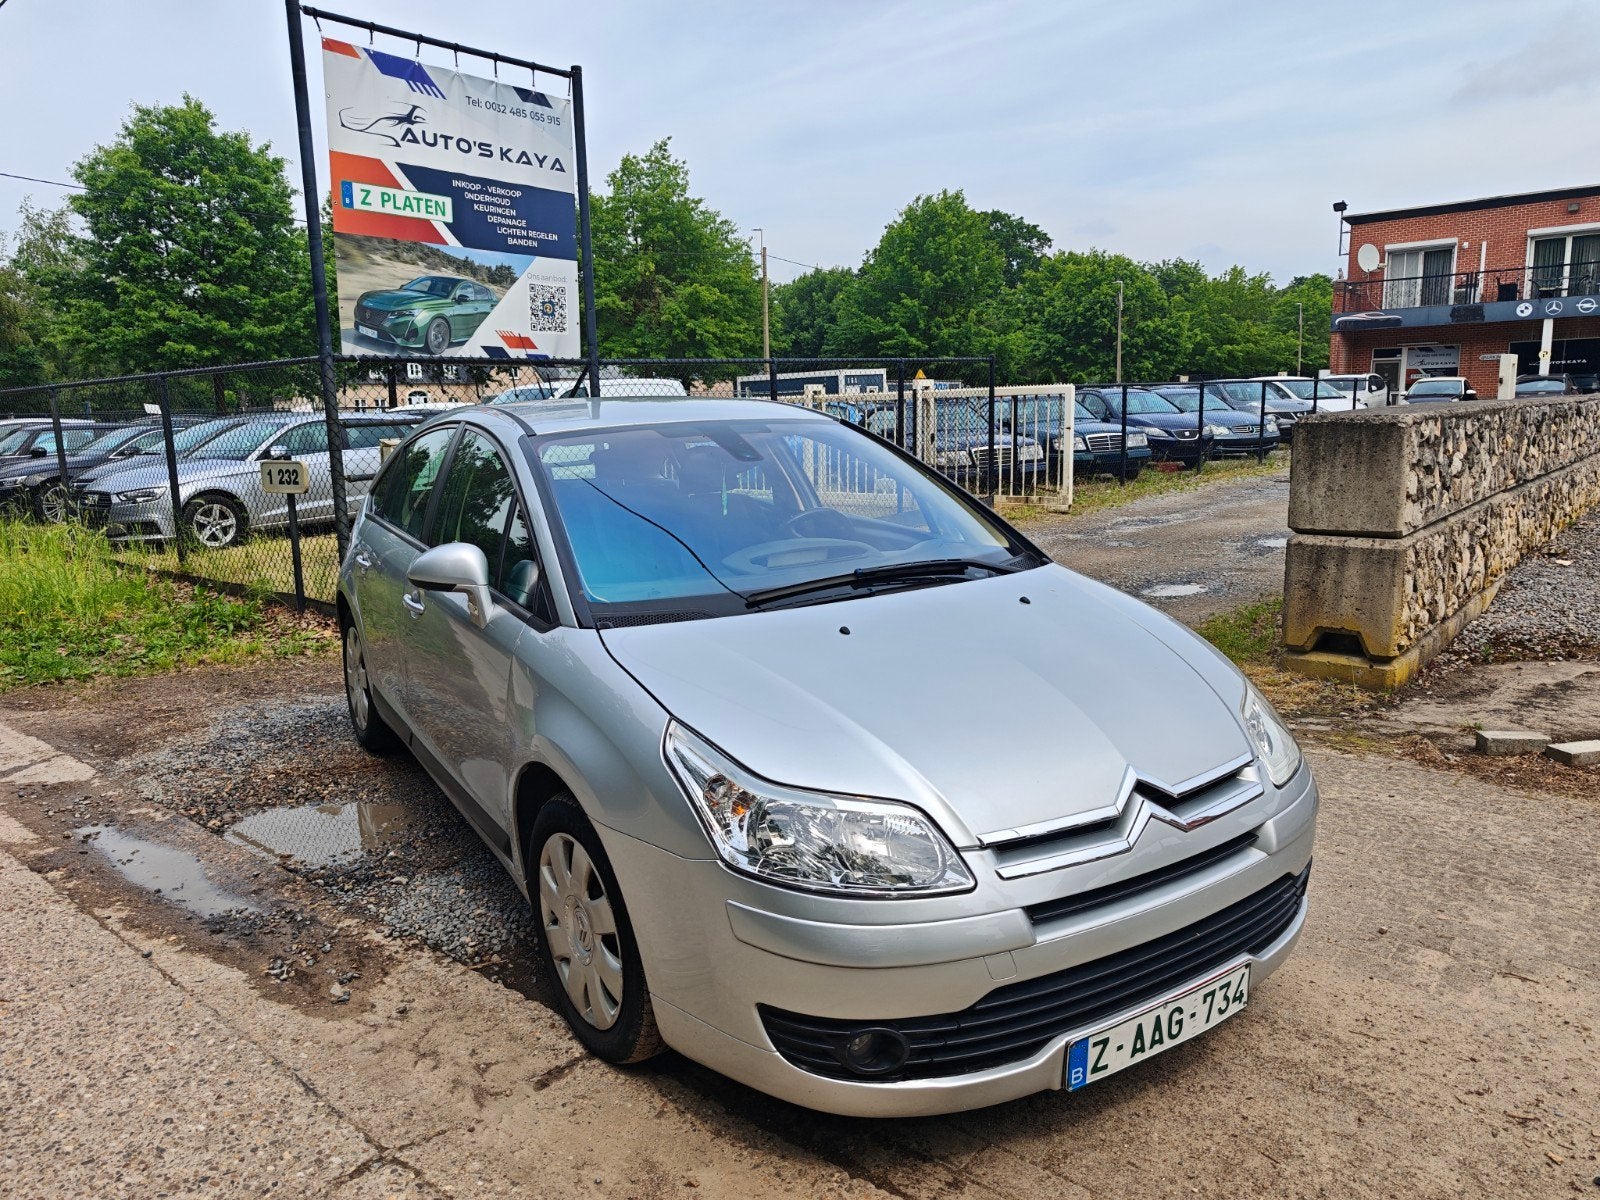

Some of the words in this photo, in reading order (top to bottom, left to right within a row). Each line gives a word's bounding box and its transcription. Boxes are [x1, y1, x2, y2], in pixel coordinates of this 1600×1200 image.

[465, 96, 483, 108] Tel:
[484, 100, 507, 114] 0032
[509, 107, 527, 118] 485
[529, 111, 545, 122] 055
[547, 115, 561, 126] 915
[400, 127, 494, 159] AUTO'S
[499, 146, 566, 173] KAYA
[452, 179, 481, 191] INKOOP
[487, 185, 522, 198] VERKOOP
[360, 188, 372, 207] Z
[380, 191, 446, 217] PLATEN
[464, 192, 511, 206] ONDERHOUD
[473, 203, 516, 217] KEURINGEN
[487, 214, 527, 227] DEPANAGE
[497, 226, 527, 237] LICHTEN
[528, 230, 558, 241] REGELEN
[507, 237, 538, 248] BANDEN
[267, 469, 273, 485] 1
[277, 469, 300, 486] 232
[1090, 972, 1247, 1075] Z-AAG-734
[1071, 1067, 1083, 1084] B
